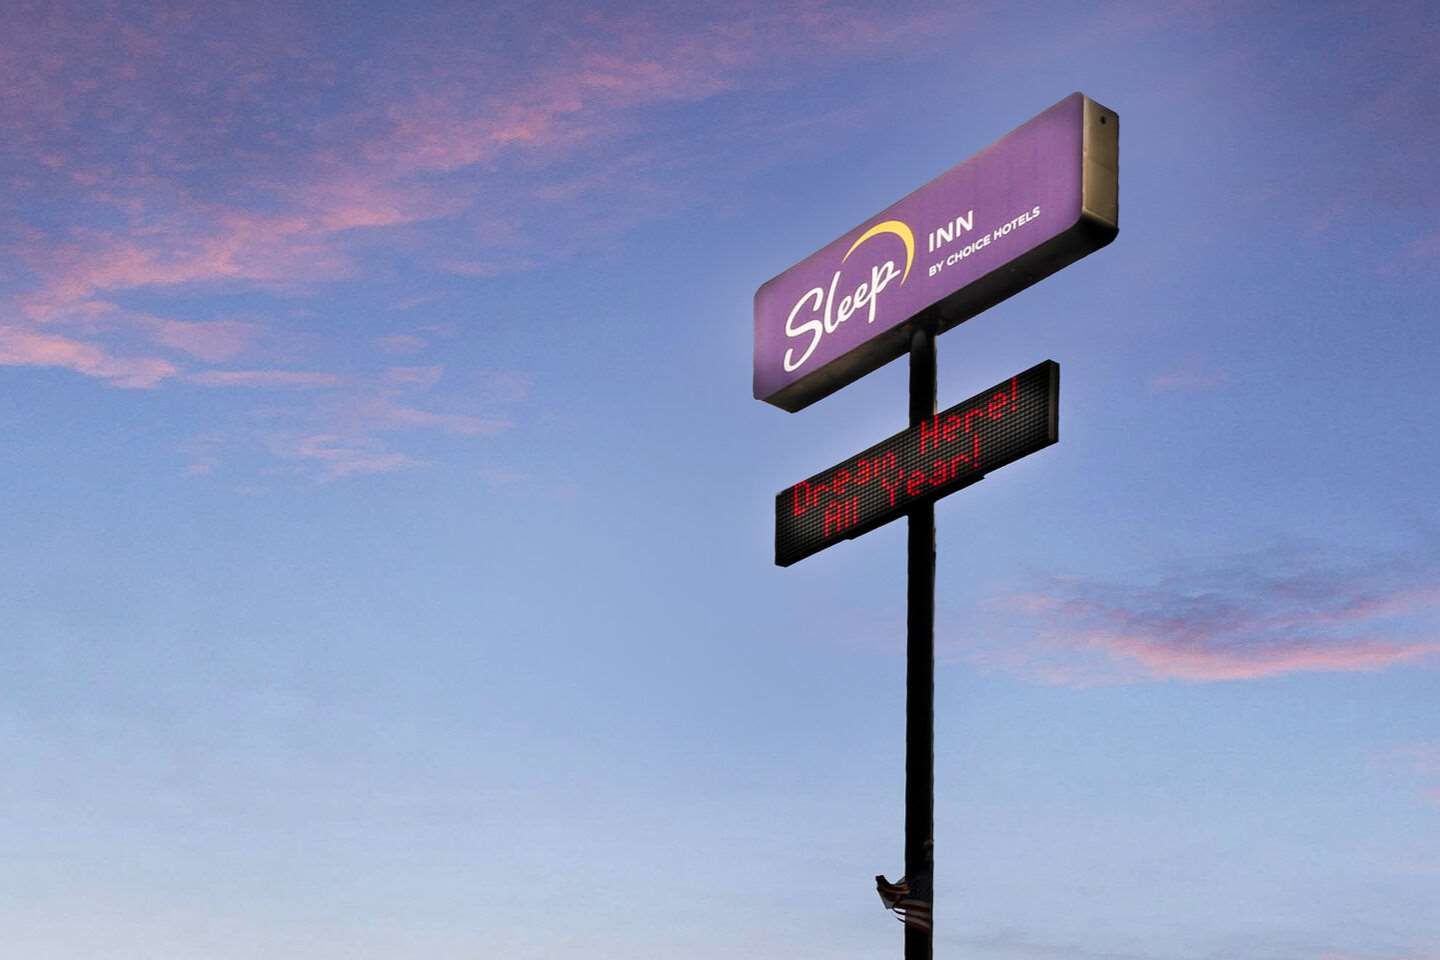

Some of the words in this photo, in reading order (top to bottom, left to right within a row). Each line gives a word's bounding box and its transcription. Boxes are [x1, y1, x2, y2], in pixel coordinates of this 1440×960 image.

[928, 210, 975, 253] INN
[928, 260, 945, 278] BY
[946, 234, 992, 266] CHOICE
[992, 205, 1041, 241] HOTELS
[783, 259, 902, 374] Sleep
[792, 450, 897, 517] Dream
[919, 376, 1018, 456] Here!
[823, 495, 859, 538] All
[880, 432, 981, 508] Year!
